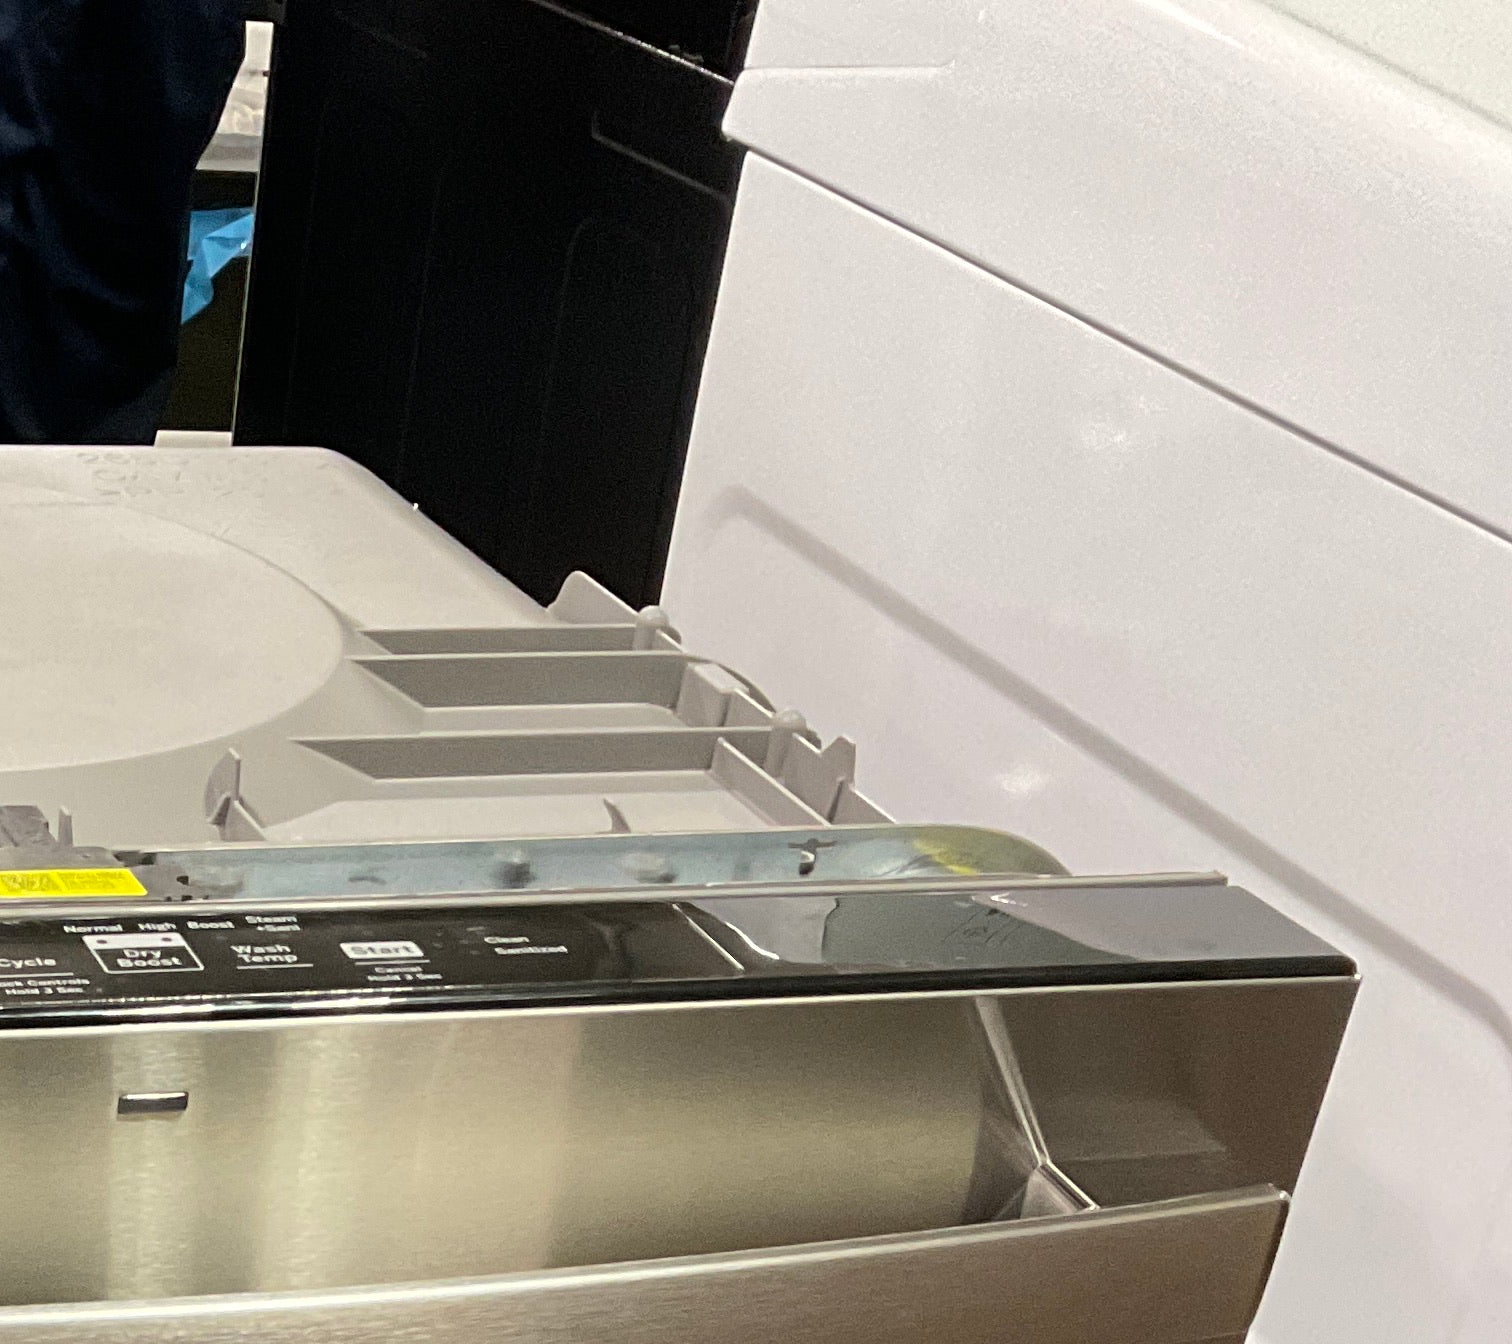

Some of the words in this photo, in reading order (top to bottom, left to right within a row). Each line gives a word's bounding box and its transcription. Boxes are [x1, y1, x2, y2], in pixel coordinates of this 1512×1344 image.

[245, 915, 298, 924] Steam
[63, 924, 123, 933] Normal
[138, 922, 177, 931] High
[186, 920, 235, 929] Boost
[230, 944, 291, 953] Wash
[350, 945, 411, 955] Start
[123, 949, 162, 959] Dry
[237, 954, 298, 963] Temp
[116, 956, 183, 968] Boost
